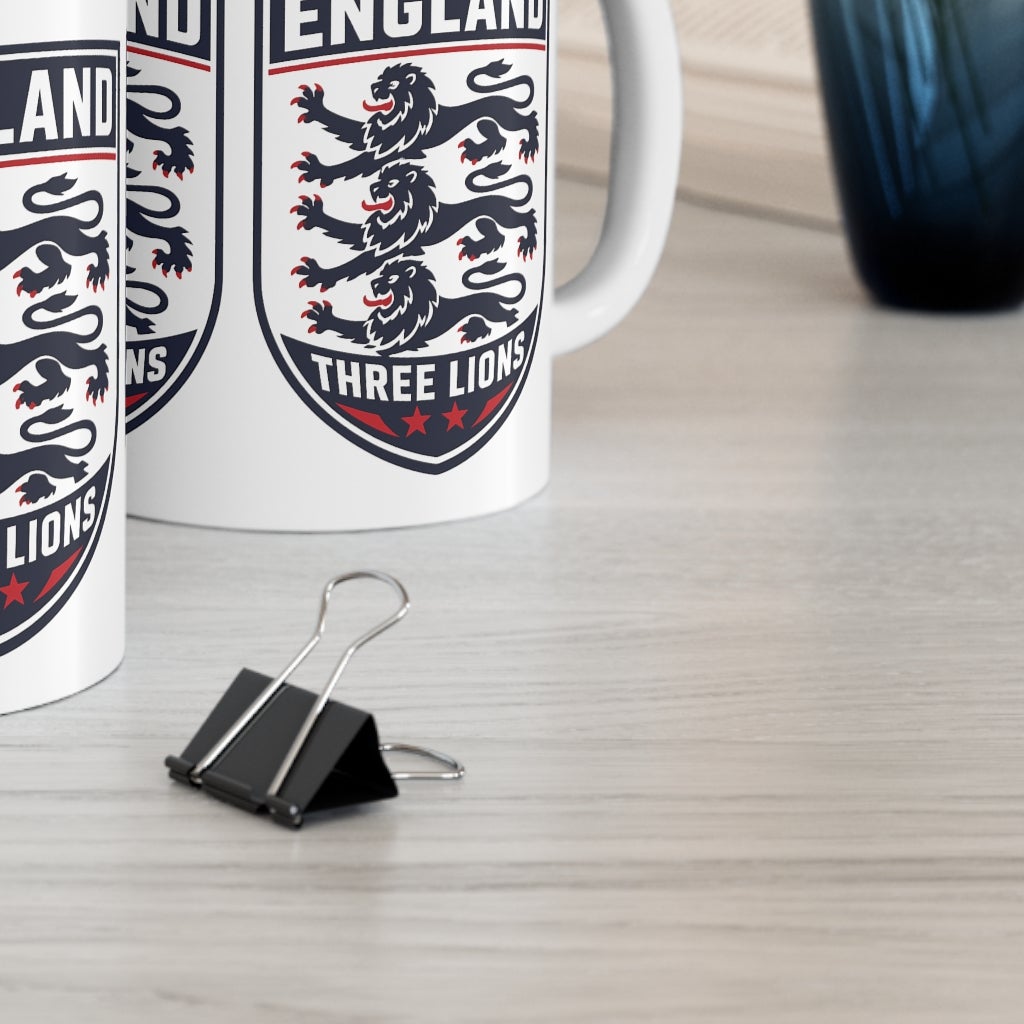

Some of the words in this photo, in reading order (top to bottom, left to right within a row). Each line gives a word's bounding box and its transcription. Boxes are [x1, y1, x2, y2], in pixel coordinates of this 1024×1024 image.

[310, 352, 436, 402] THREE
[449, 338, 525, 398] LIONS
[6, 485, 97, 569] LIONS
